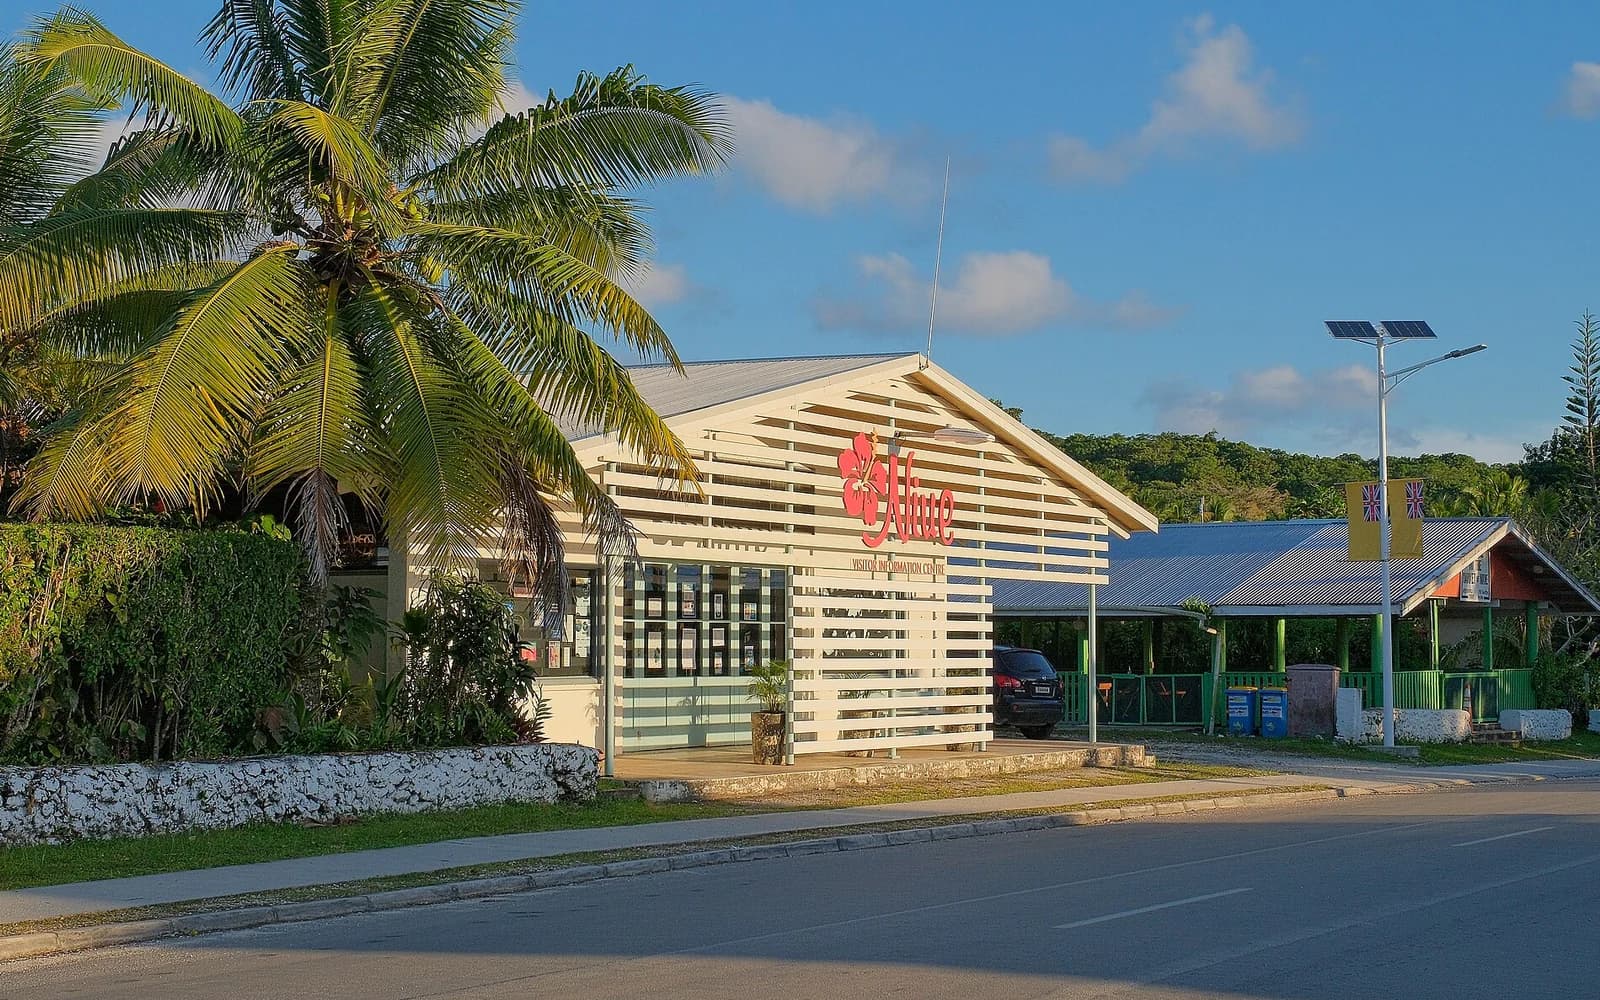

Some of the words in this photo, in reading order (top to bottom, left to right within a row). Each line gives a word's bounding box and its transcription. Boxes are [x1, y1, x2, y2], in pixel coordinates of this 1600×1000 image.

[862, 451, 954, 548] Niue
[852, 558, 877, 571] VISITOR
[879, 560, 922, 575] INFORMATION
[922, 562, 945, 576] CENTRE
